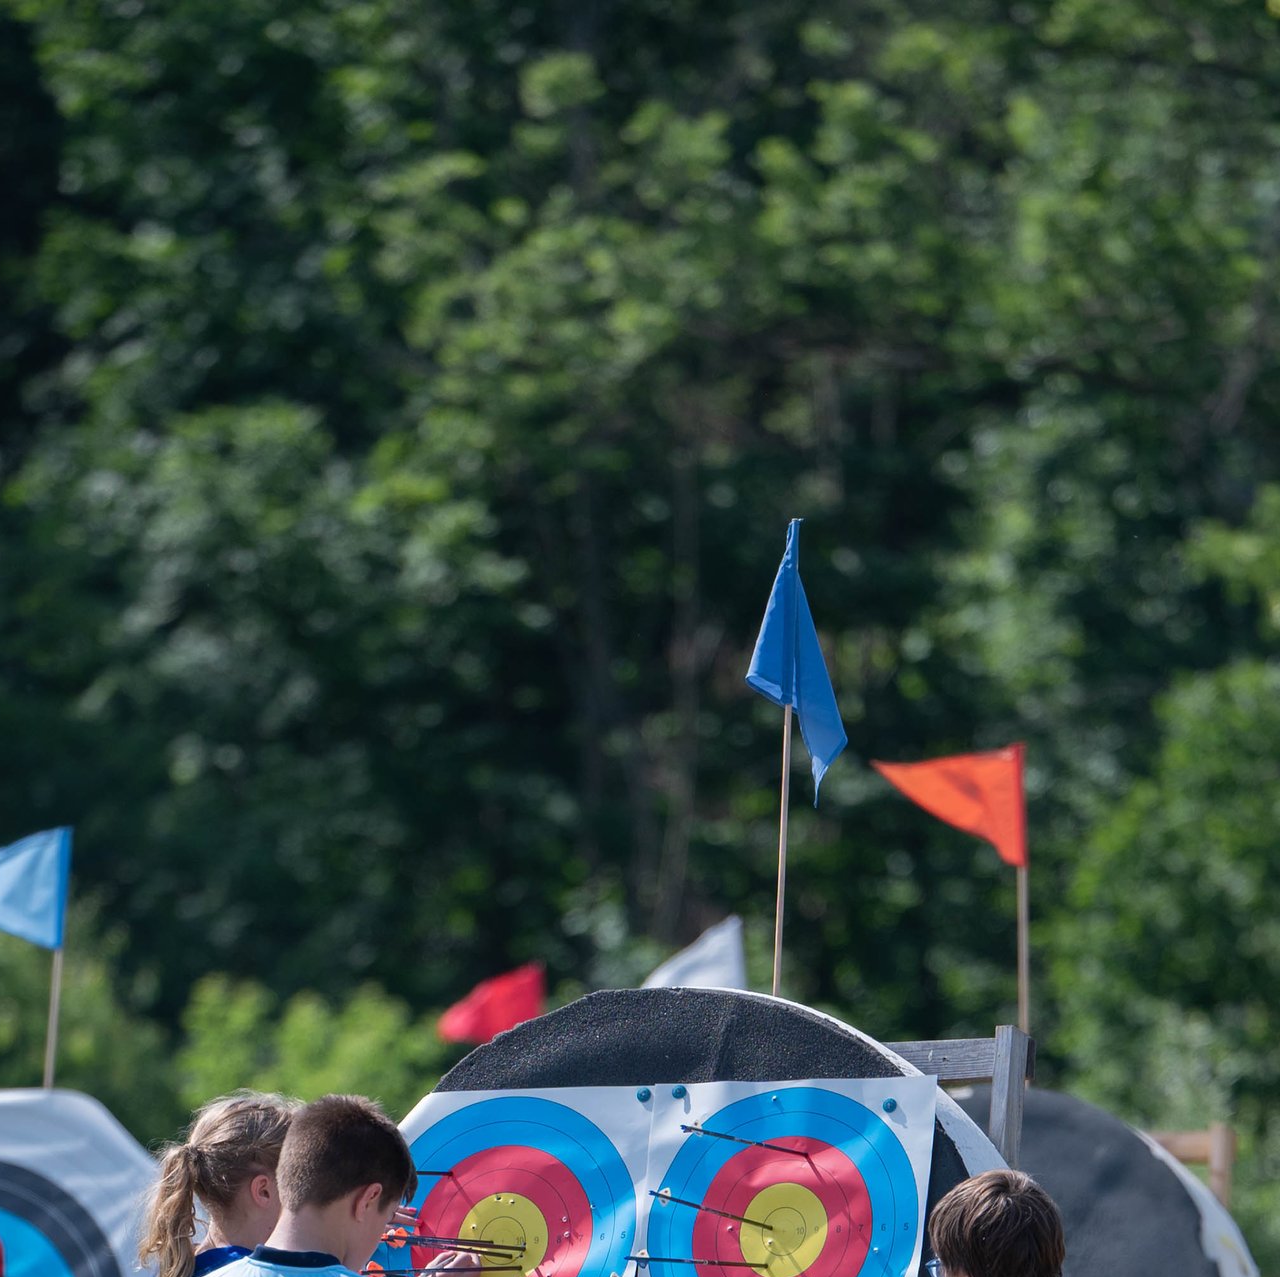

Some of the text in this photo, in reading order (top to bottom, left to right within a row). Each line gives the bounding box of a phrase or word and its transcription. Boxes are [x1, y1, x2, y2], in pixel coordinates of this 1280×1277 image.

[836, 1224, 841, 1233] 8
[858, 1223, 864, 1232] 7
[881, 1223, 887, 1232] 6
[903, 1222, 909, 1231] 5
[600, 1232, 605, 1241] 6
[621, 1230, 626, 1239] 5
